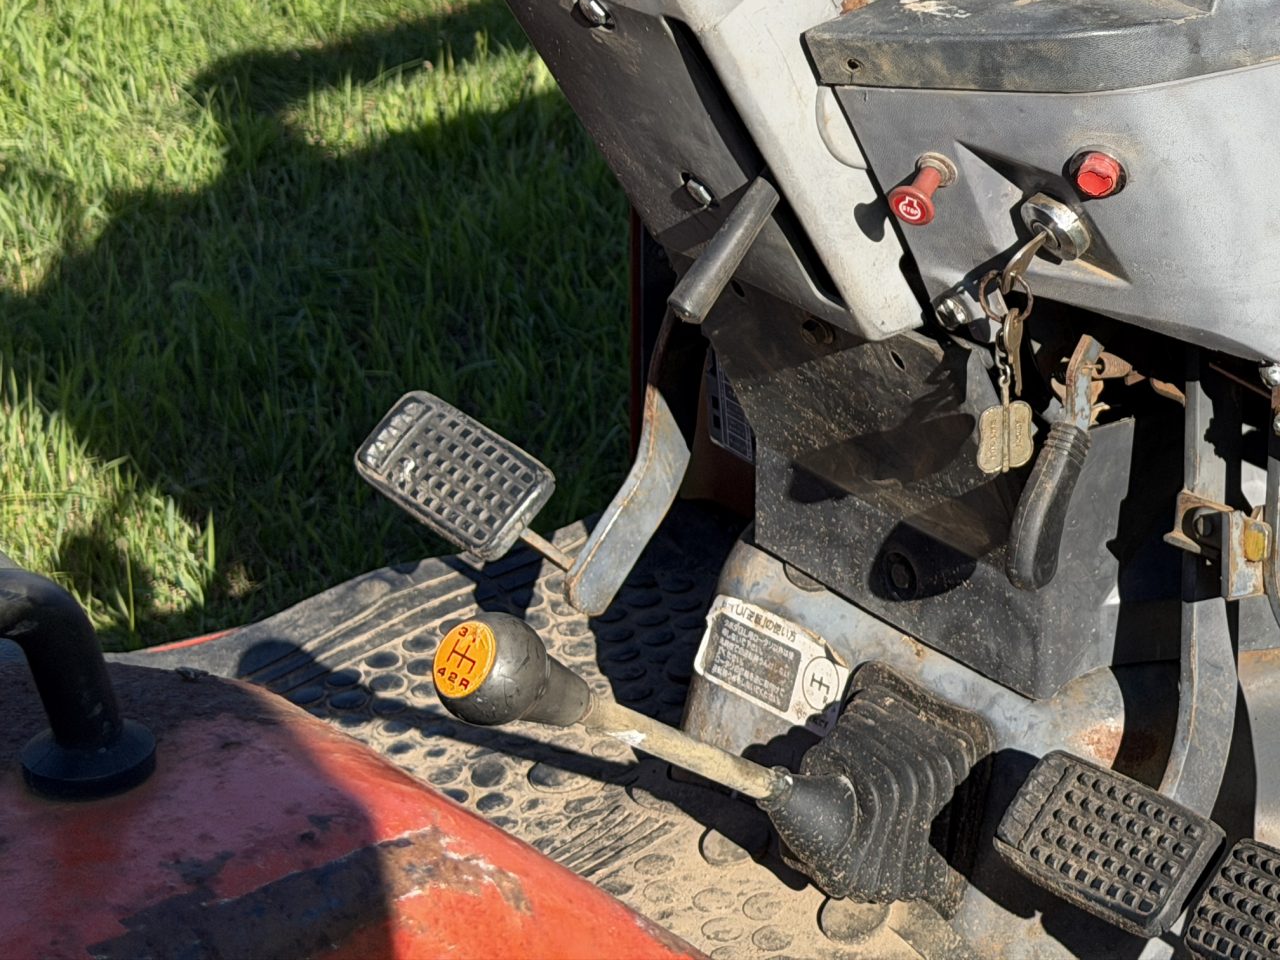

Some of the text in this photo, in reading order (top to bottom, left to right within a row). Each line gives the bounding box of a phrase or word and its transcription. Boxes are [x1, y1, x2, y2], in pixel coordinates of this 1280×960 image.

[902, 204, 919, 216] STOP
[458, 626, 469, 638] 3
[437, 667, 470, 690] 4 2 R
